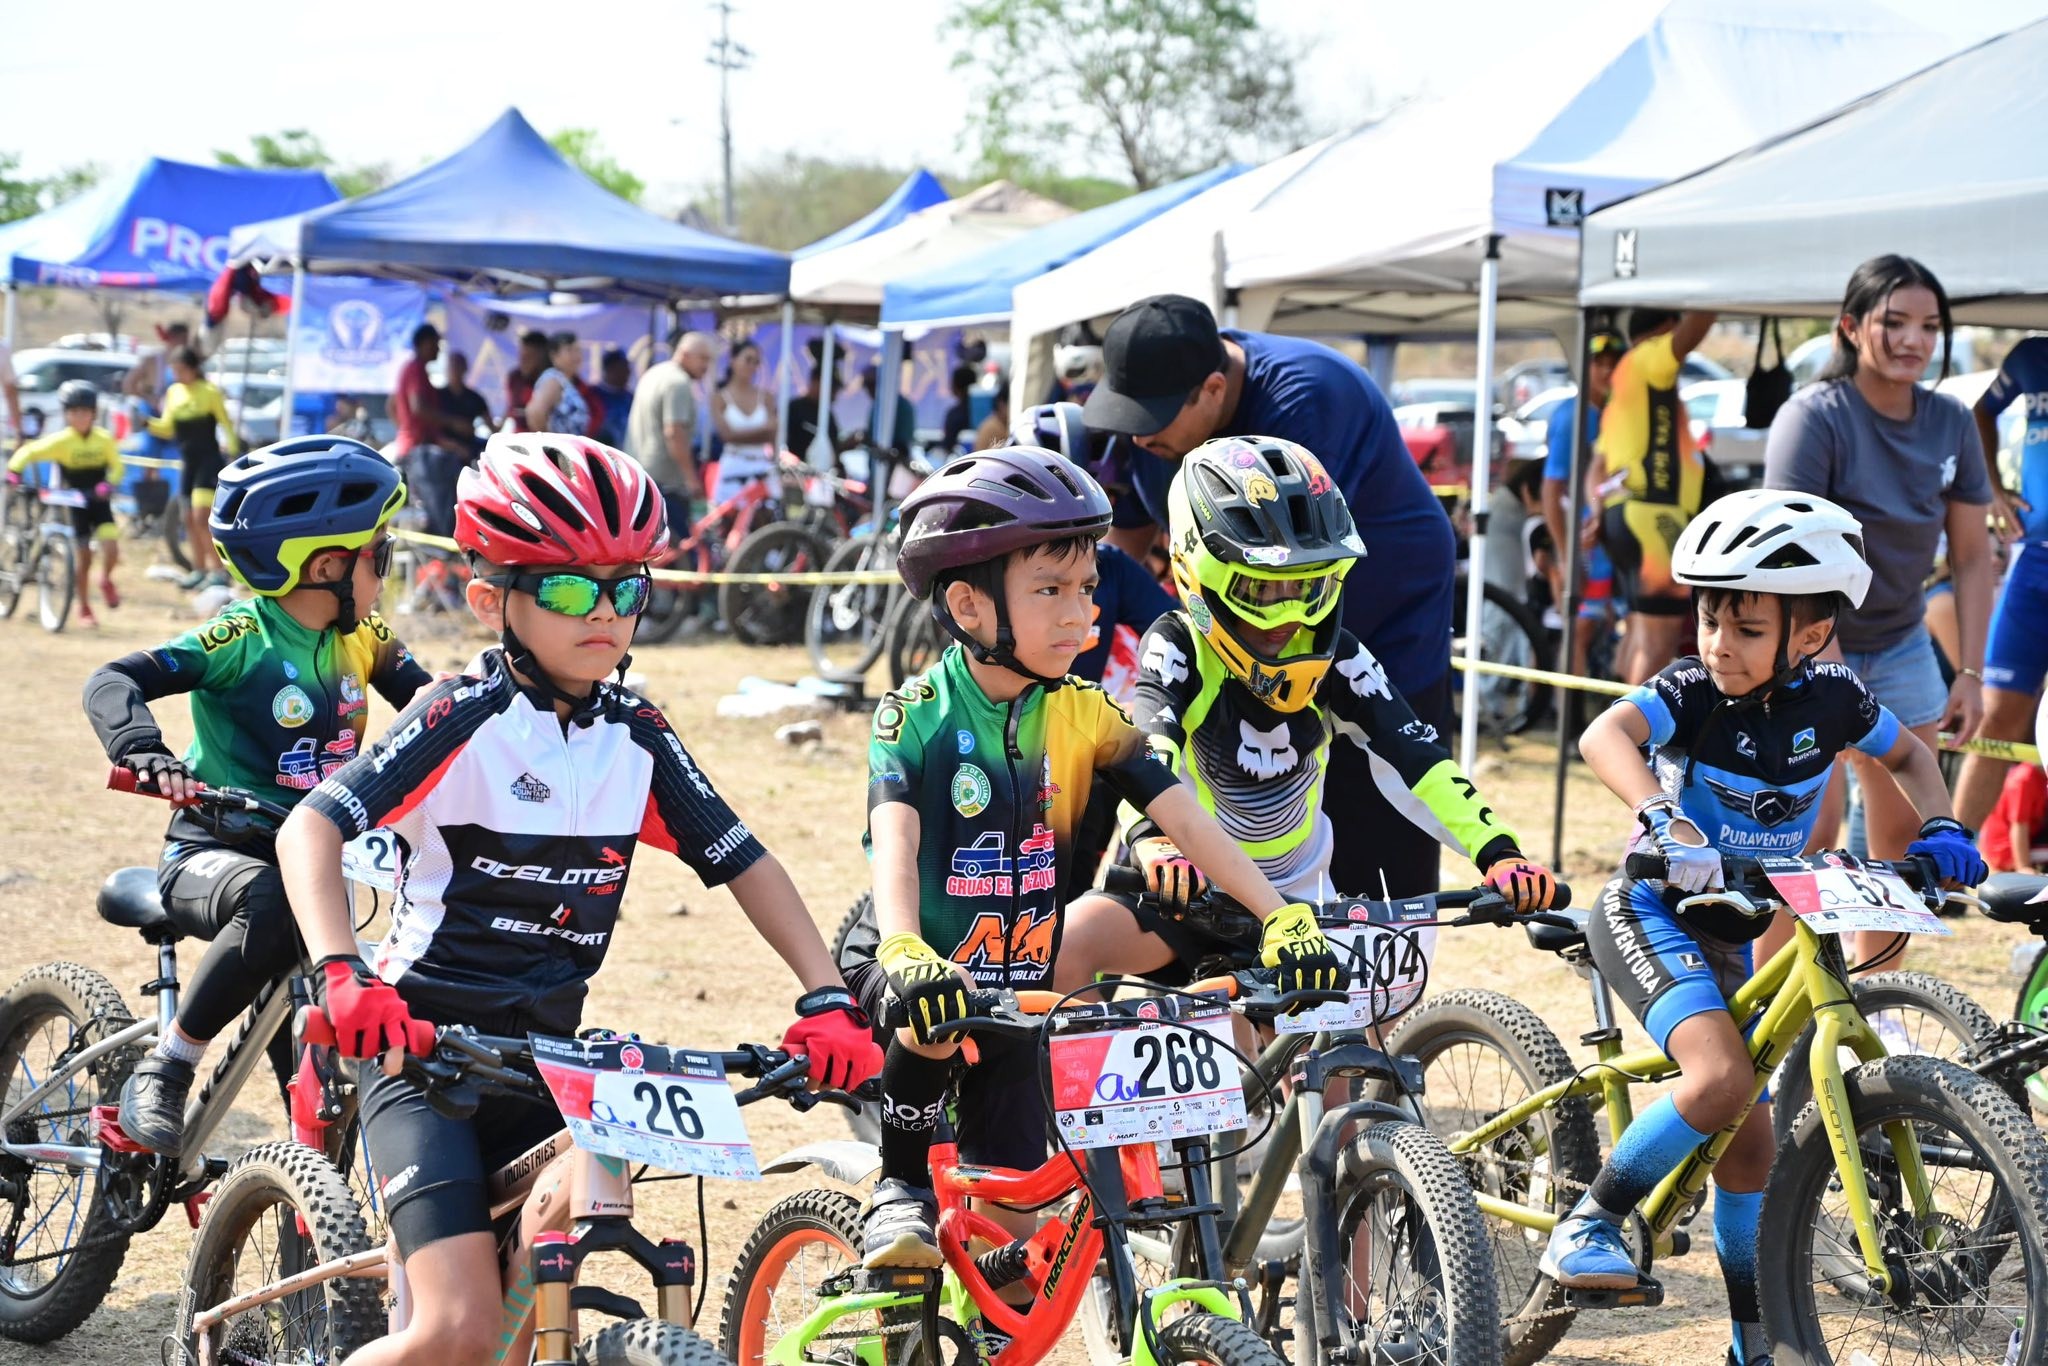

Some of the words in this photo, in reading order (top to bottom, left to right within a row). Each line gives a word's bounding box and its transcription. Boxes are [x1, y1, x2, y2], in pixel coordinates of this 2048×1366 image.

[1719, 824, 1803, 846] PURAVENTURA
[471, 855, 626, 885] OCELOTES
[947, 876, 993, 897] GRUAS
[1844, 872, 1906, 910] 52
[490, 916, 608, 946] BELFORT
[1603, 879, 1661, 994] PURAVENTURA
[1289, 936, 1330, 961] FOX
[1347, 931, 1419, 988] 404
[903, 963, 949, 986] FOX
[1194, 1008, 1223, 1018] REALTRUCK
[685, 1055, 709, 1065] THULE
[1133, 1029, 1221, 1099] 268
[633, 1081, 704, 1140] 26
[1820, 1077, 1853, 1162] SCOTT
[504, 1139, 556, 1188] INDUSTRIES
[1043, 1192, 1091, 1300] MERCURIO
